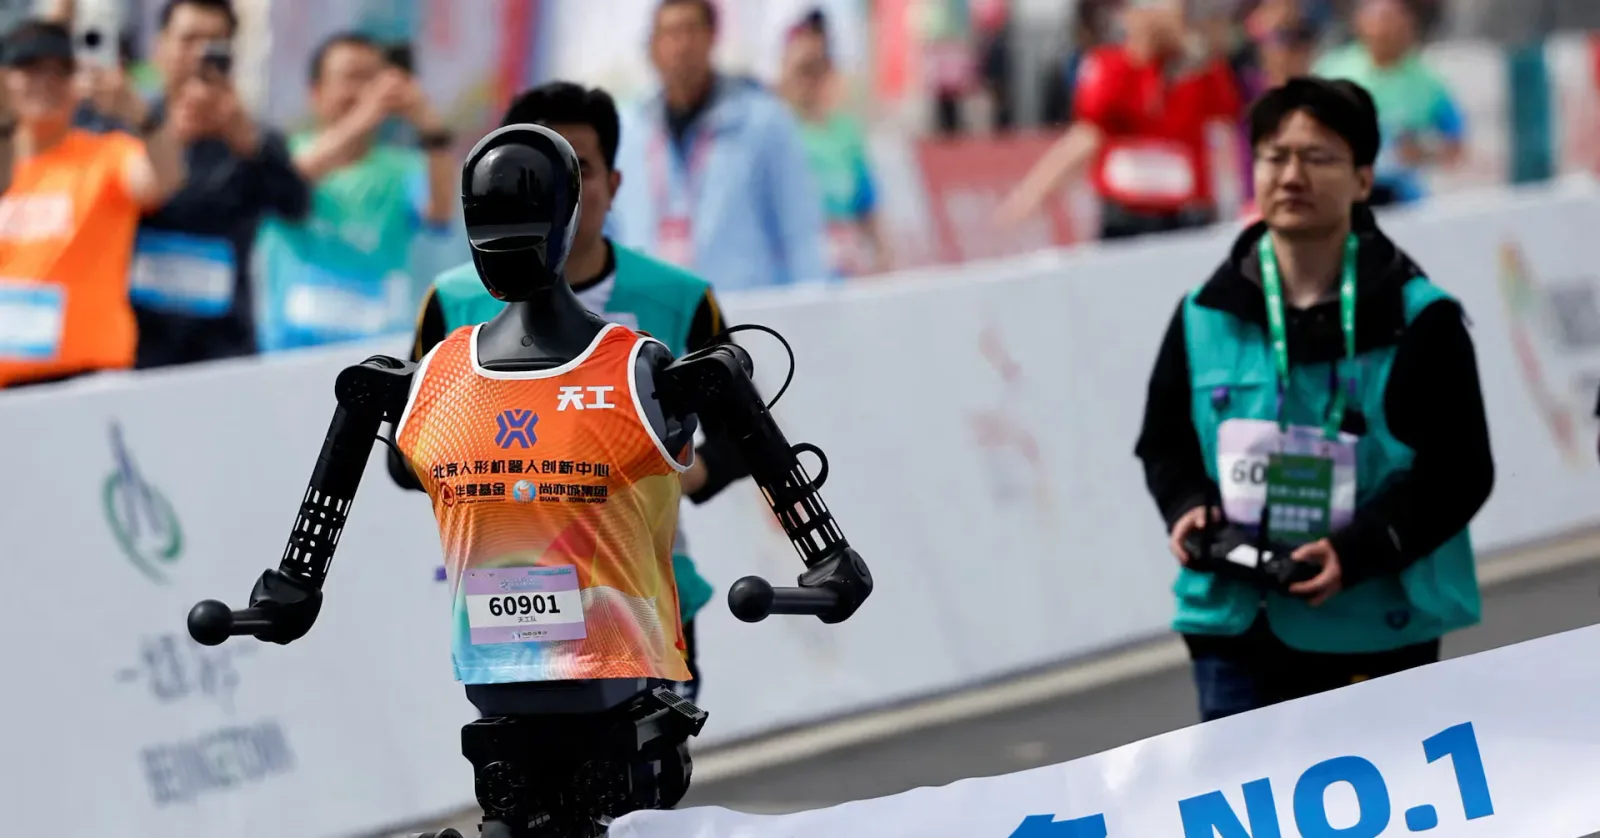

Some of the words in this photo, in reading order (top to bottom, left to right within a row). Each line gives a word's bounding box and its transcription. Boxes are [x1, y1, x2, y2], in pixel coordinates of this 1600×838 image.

[557, 386, 615, 411] 天工
[433, 460, 609, 478] 北京人形机器人创新中心
[489, 595, 560, 616] 60901
[1179, 721, 1494, 838] NO.1
